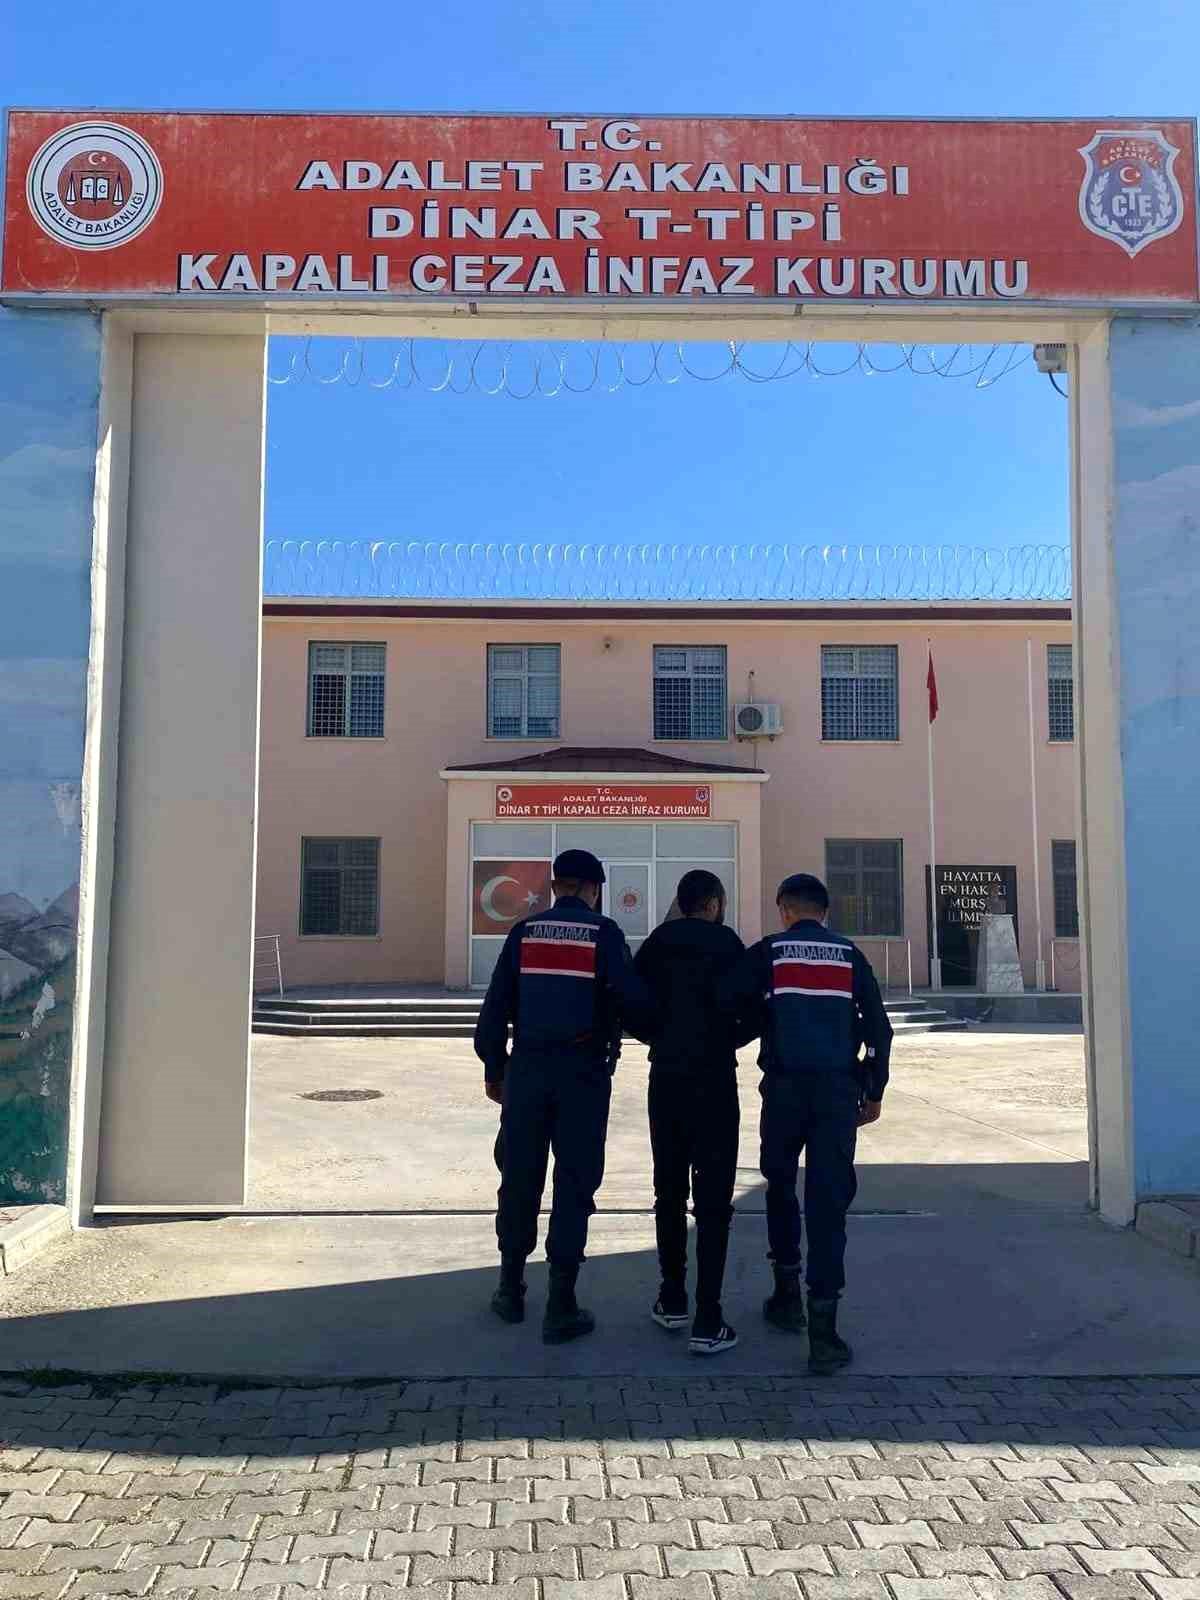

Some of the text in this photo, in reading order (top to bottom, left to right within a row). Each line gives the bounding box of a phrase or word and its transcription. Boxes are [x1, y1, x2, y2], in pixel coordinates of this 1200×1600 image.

[547, 119, 662, 152] T.C.
[297, 158, 910, 196] ADALET BAKANLIĞI
[45, 191, 82, 231] ADALET
[1111, 187, 1153, 218] CTE
[369, 200, 842, 242] DİNAR T-TİPİ
[177, 248, 1030, 297] KAPALI CEZA İNFAZ KURUMU
[499, 803, 531, 815] DİNAR
[533, 805, 540, 815] T
[563, 805, 600, 815] KAPALI
[602, 805, 628, 815] CEZA
[631, 803, 661, 816] İNFAZ
[663, 805, 708, 816] KURUMU
[940, 885, 957, 895] EN
[943, 871, 1001, 881] HAYATTA
[529, 925, 592, 942] JANDARMA
[780, 944, 845, 961] JANDARMA
